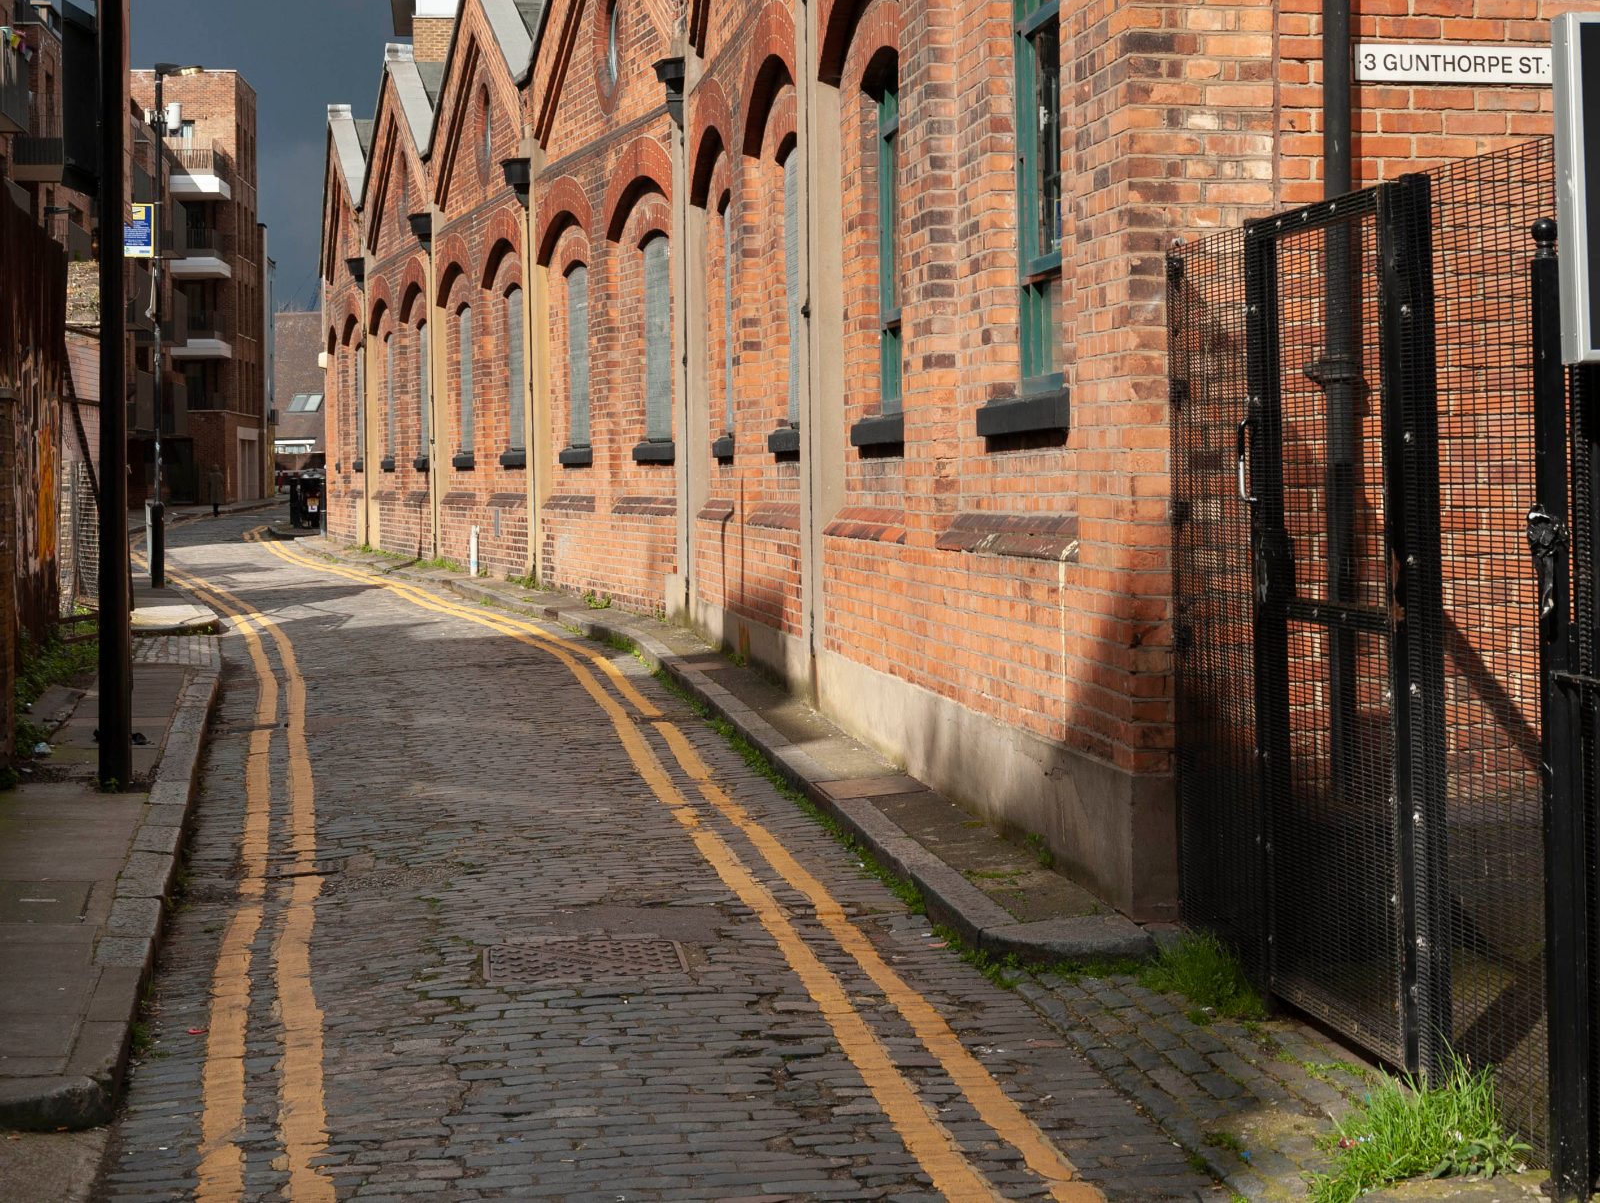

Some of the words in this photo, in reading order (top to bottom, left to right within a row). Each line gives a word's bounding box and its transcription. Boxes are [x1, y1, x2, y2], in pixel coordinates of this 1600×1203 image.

[1364, 53, 1376, 71] 3
[1383, 53, 1512, 73] GUNTHORPE
[1519, 56, 1545, 74] ST.
